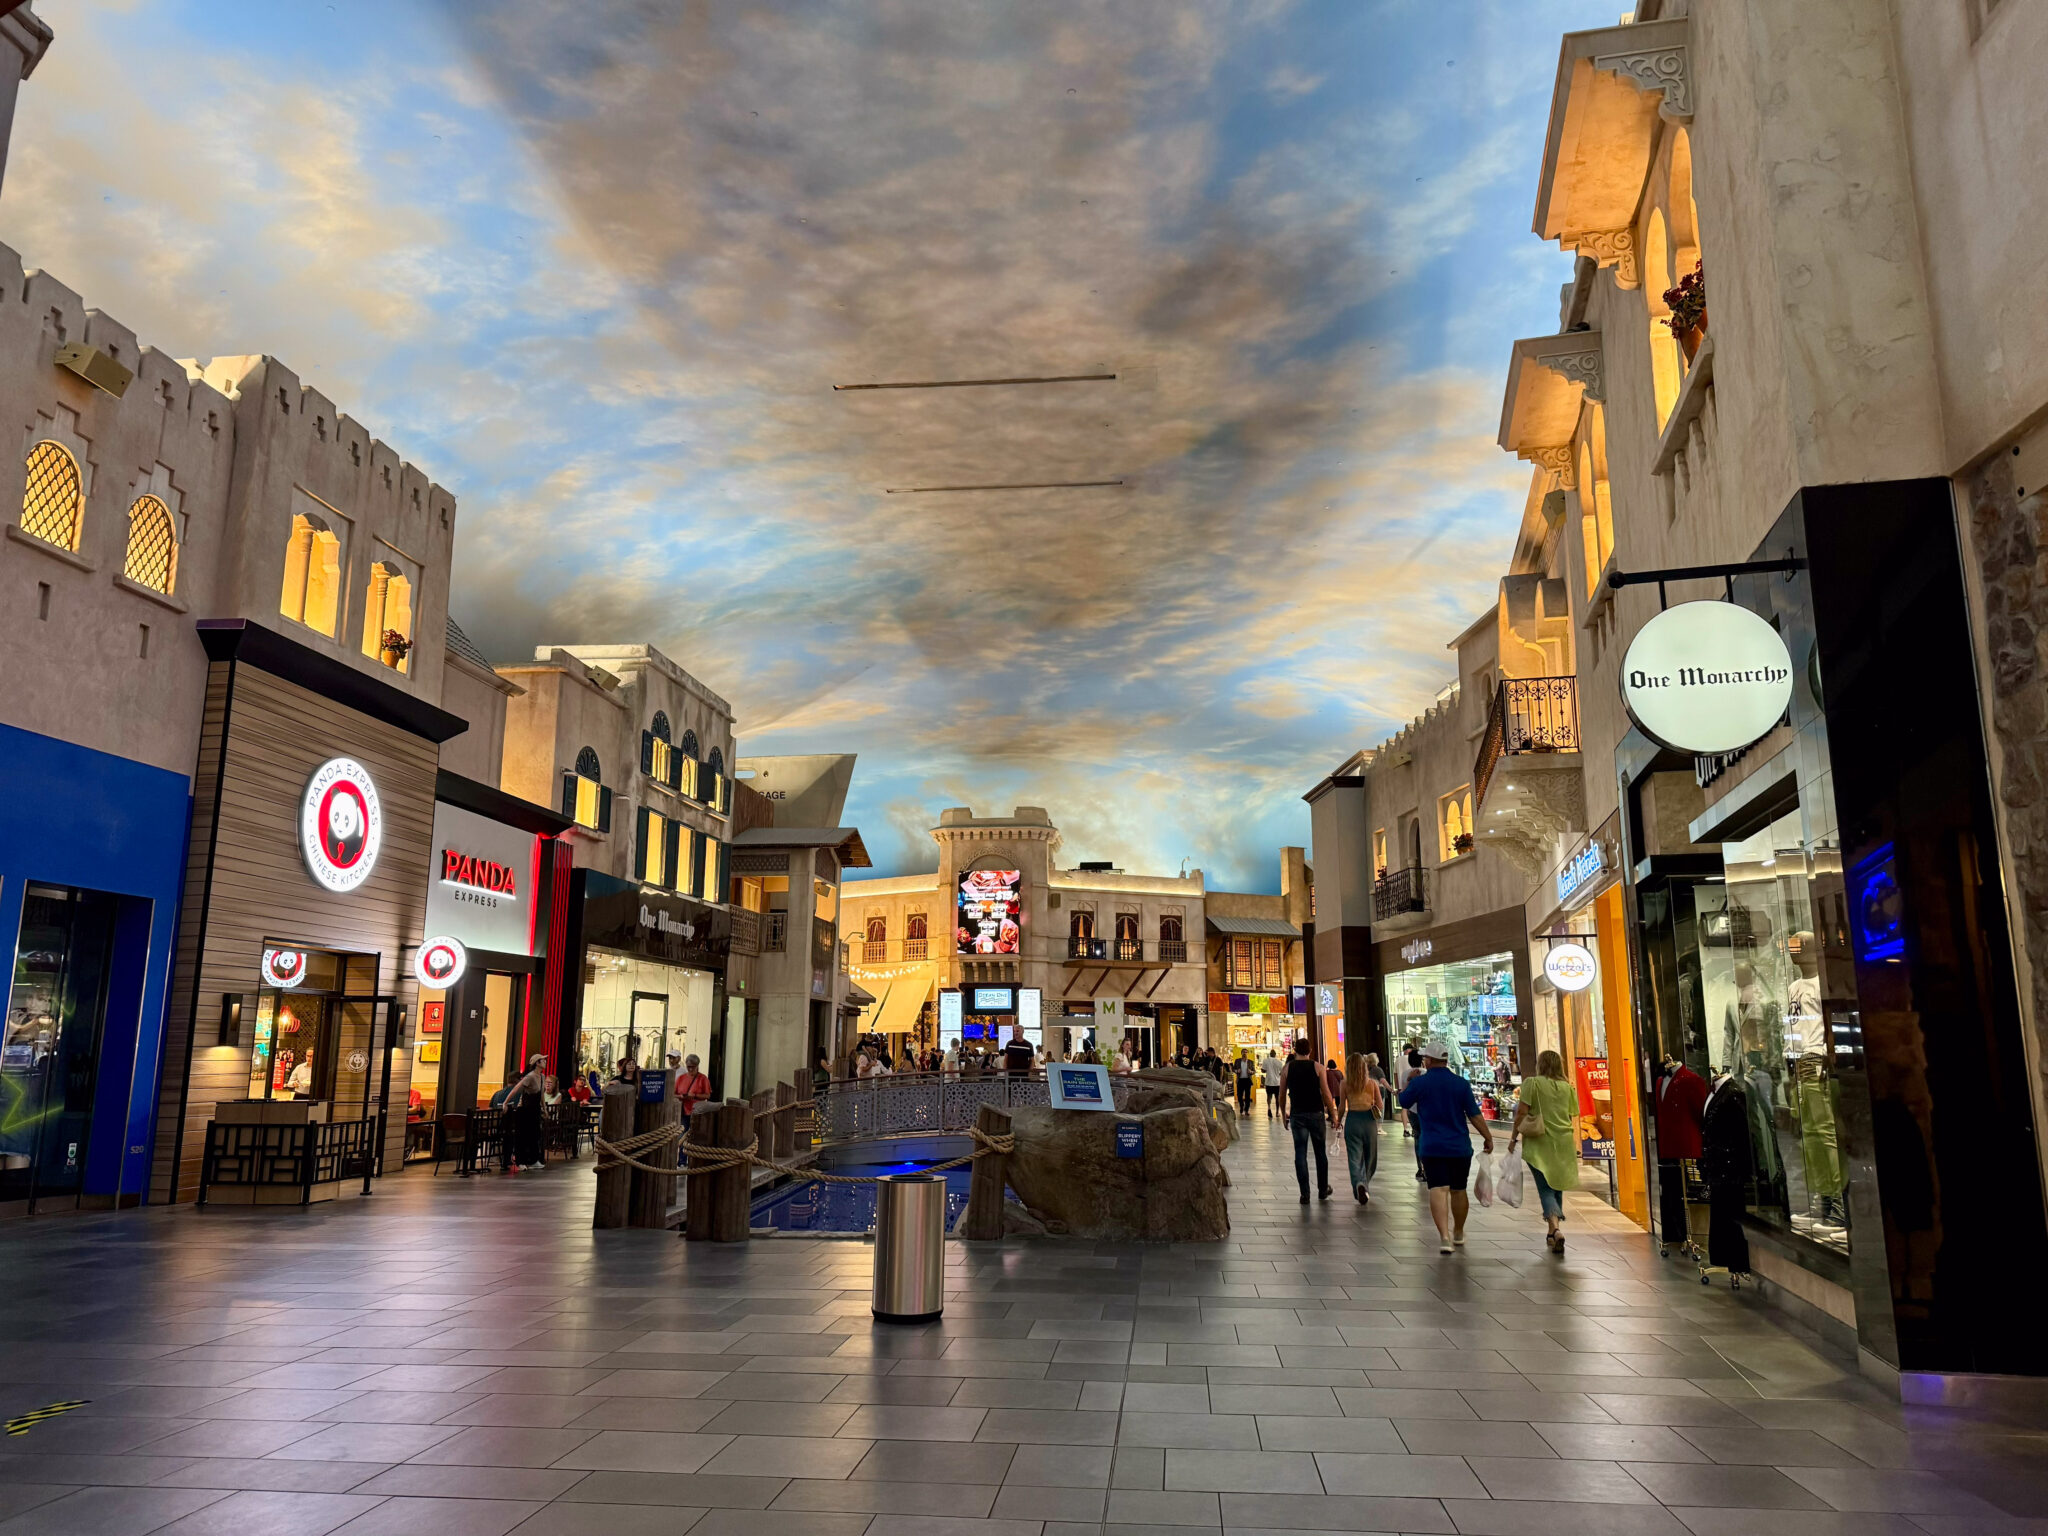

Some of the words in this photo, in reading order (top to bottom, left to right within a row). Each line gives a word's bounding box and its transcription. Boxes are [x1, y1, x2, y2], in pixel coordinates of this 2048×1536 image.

[1630, 670, 1670, 689] One
[1678, 665, 1788, 687] Monarchy
[309, 763, 342, 807] PANDA
[347, 763, 378, 826] EXPRESS
[309, 834, 338, 884] CHINESE
[341, 850, 373, 886] KITCHEN
[444, 849, 516, 896] PANDA
[454, 890, 497, 908] EXPRESS
[640, 904, 656, 928] One
[658, 909, 695, 941] Monarchy
[1548, 962, 1592, 972] Wetzel's
[1103, 1001, 1116, 1014] M
